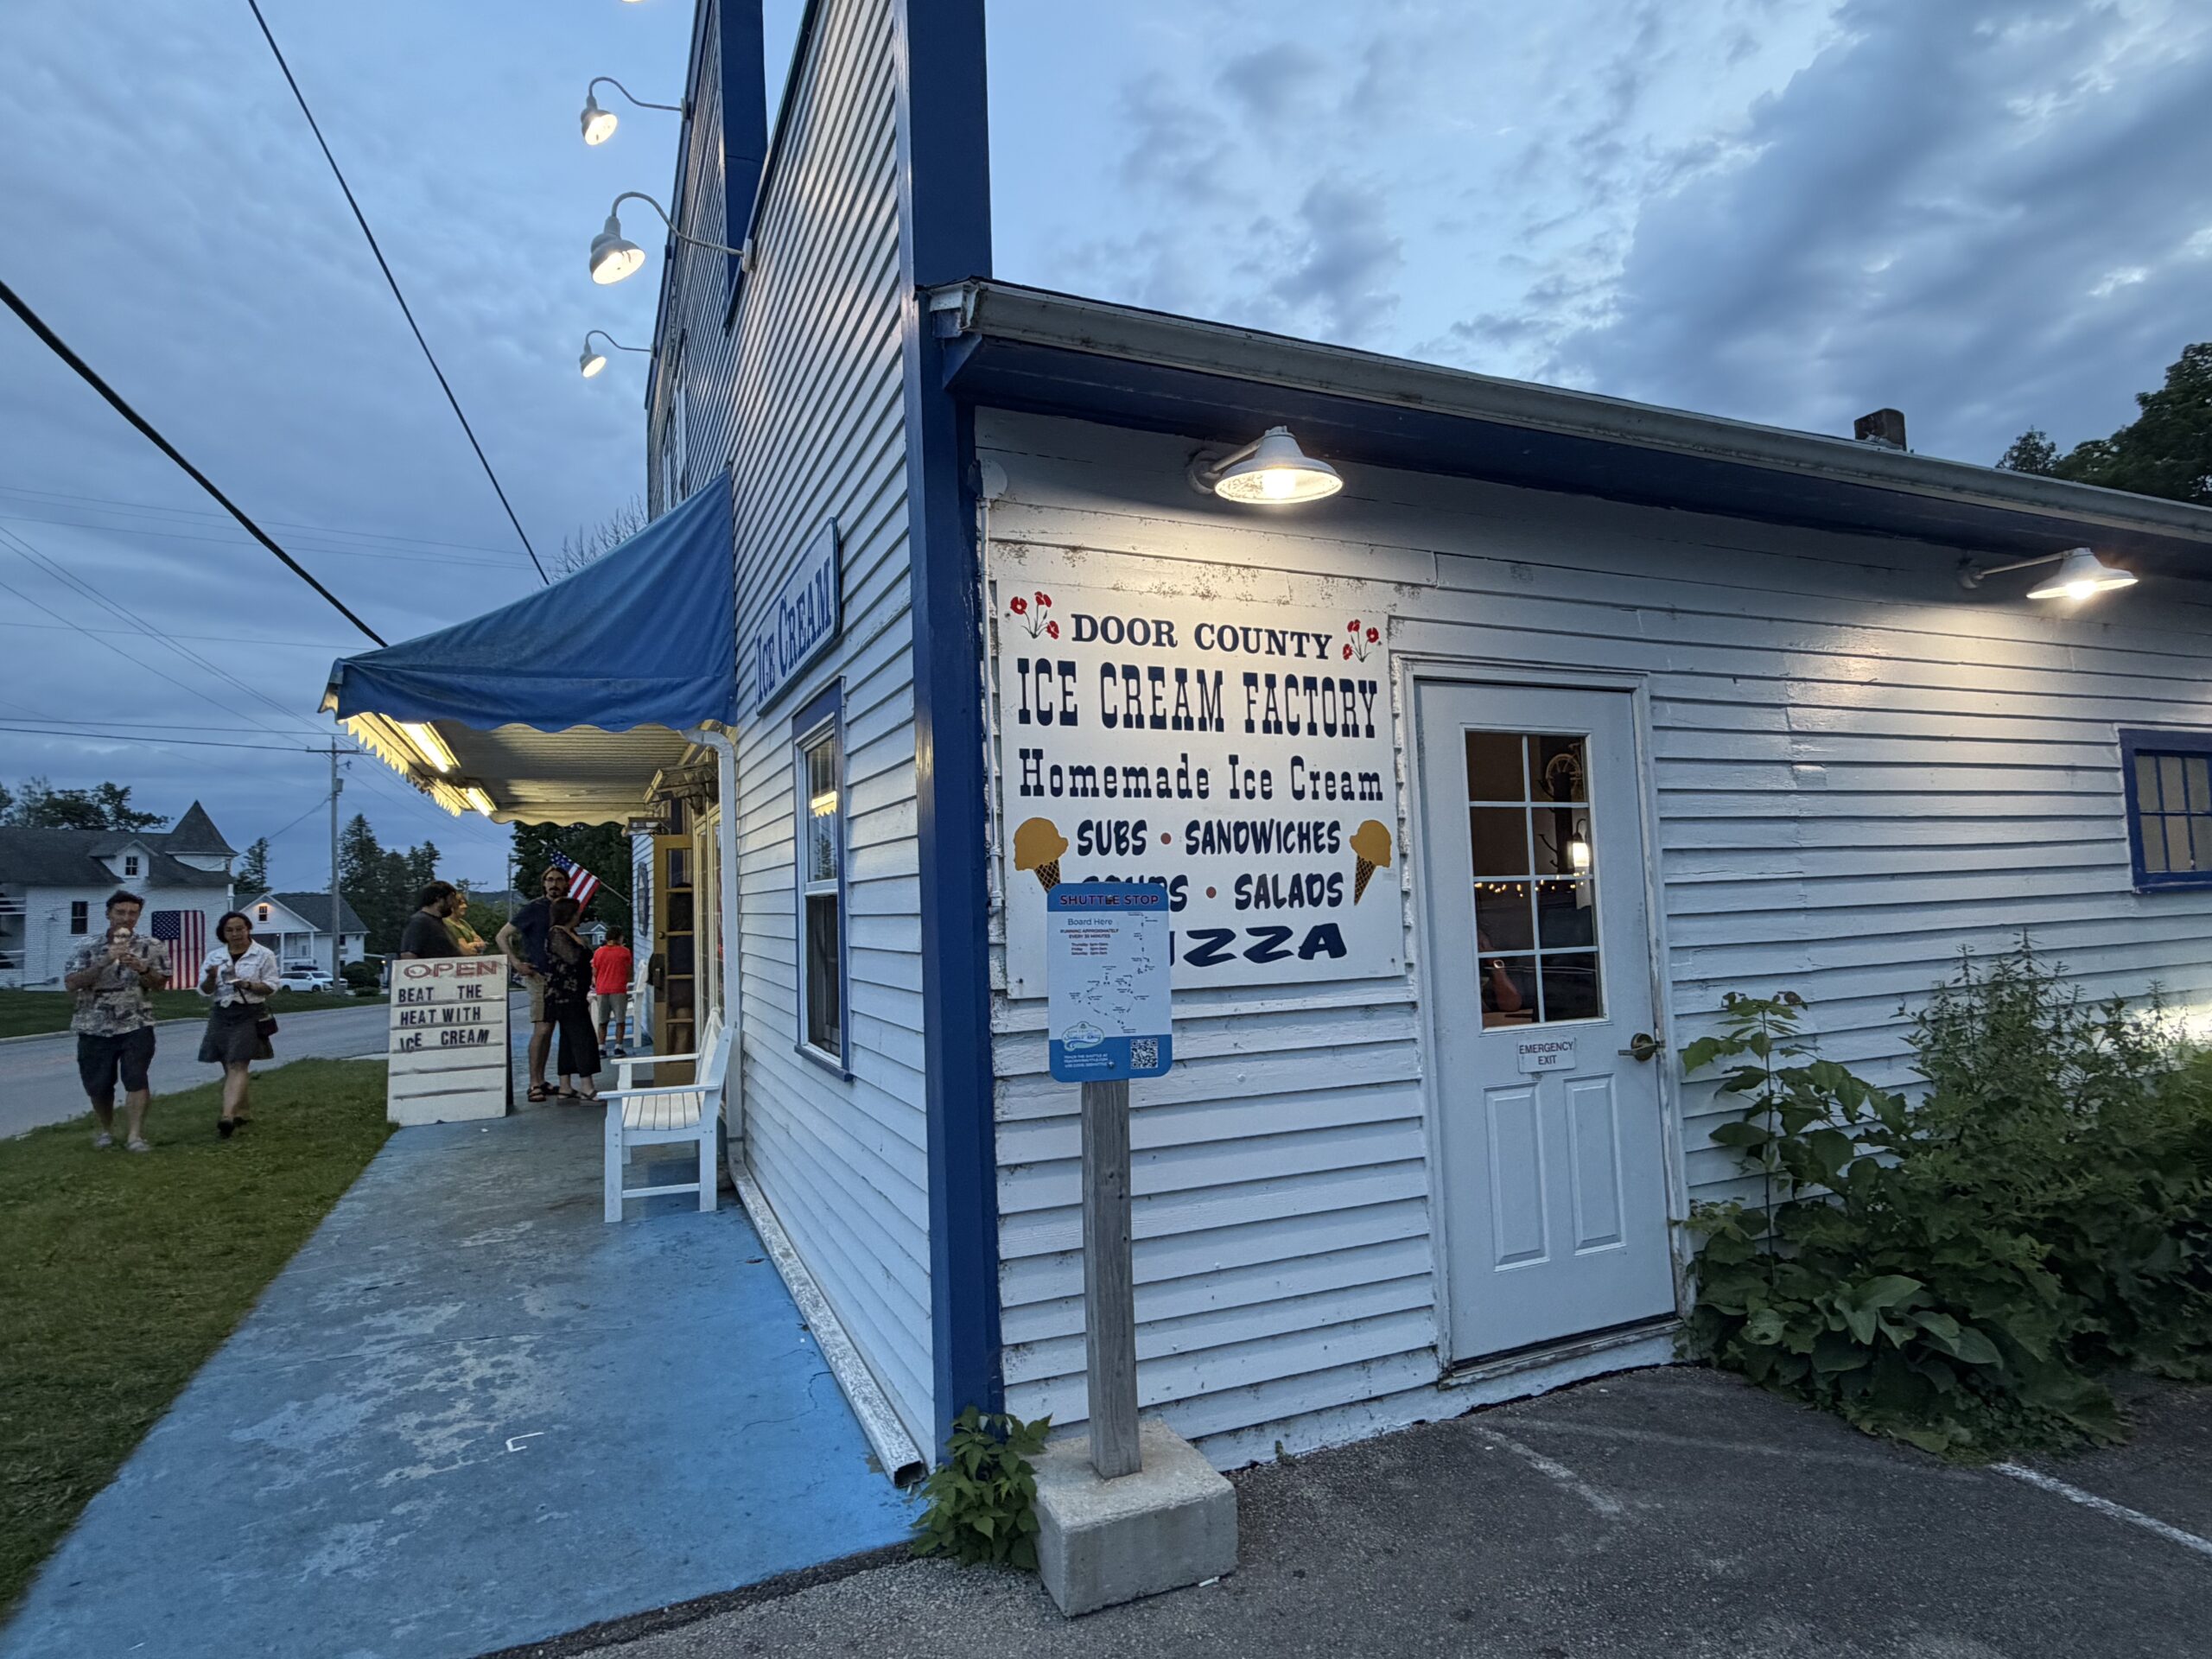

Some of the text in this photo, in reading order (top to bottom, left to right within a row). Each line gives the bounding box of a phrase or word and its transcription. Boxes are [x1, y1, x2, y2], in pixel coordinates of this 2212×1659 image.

[757, 556, 832, 705] ICE CREAM
[1071, 613, 1333, 660] DOOR COUNTY
[1017, 658, 1377, 739] ICE CREAM FACTORY
[1019, 748, 1384, 802] Homemade Ice Cream
[1077, 817, 1341, 856] SUBS SANDWICHES
[1060, 894, 1159, 906] SHUTTLE STOP
[1234, 871, 1344, 910] SALADS
[1169, 922, 1348, 968] ZZA
[404, 961, 498, 979] OPEN
[398, 984, 482, 1002] BEAT THE
[400, 1007, 480, 1026] HEAT WITH
[400, 1029, 490, 1052] ICE CREAM
[1519, 1041, 1573, 1054] EMERGENCY
[1538, 1055, 1557, 1065] EXIT
